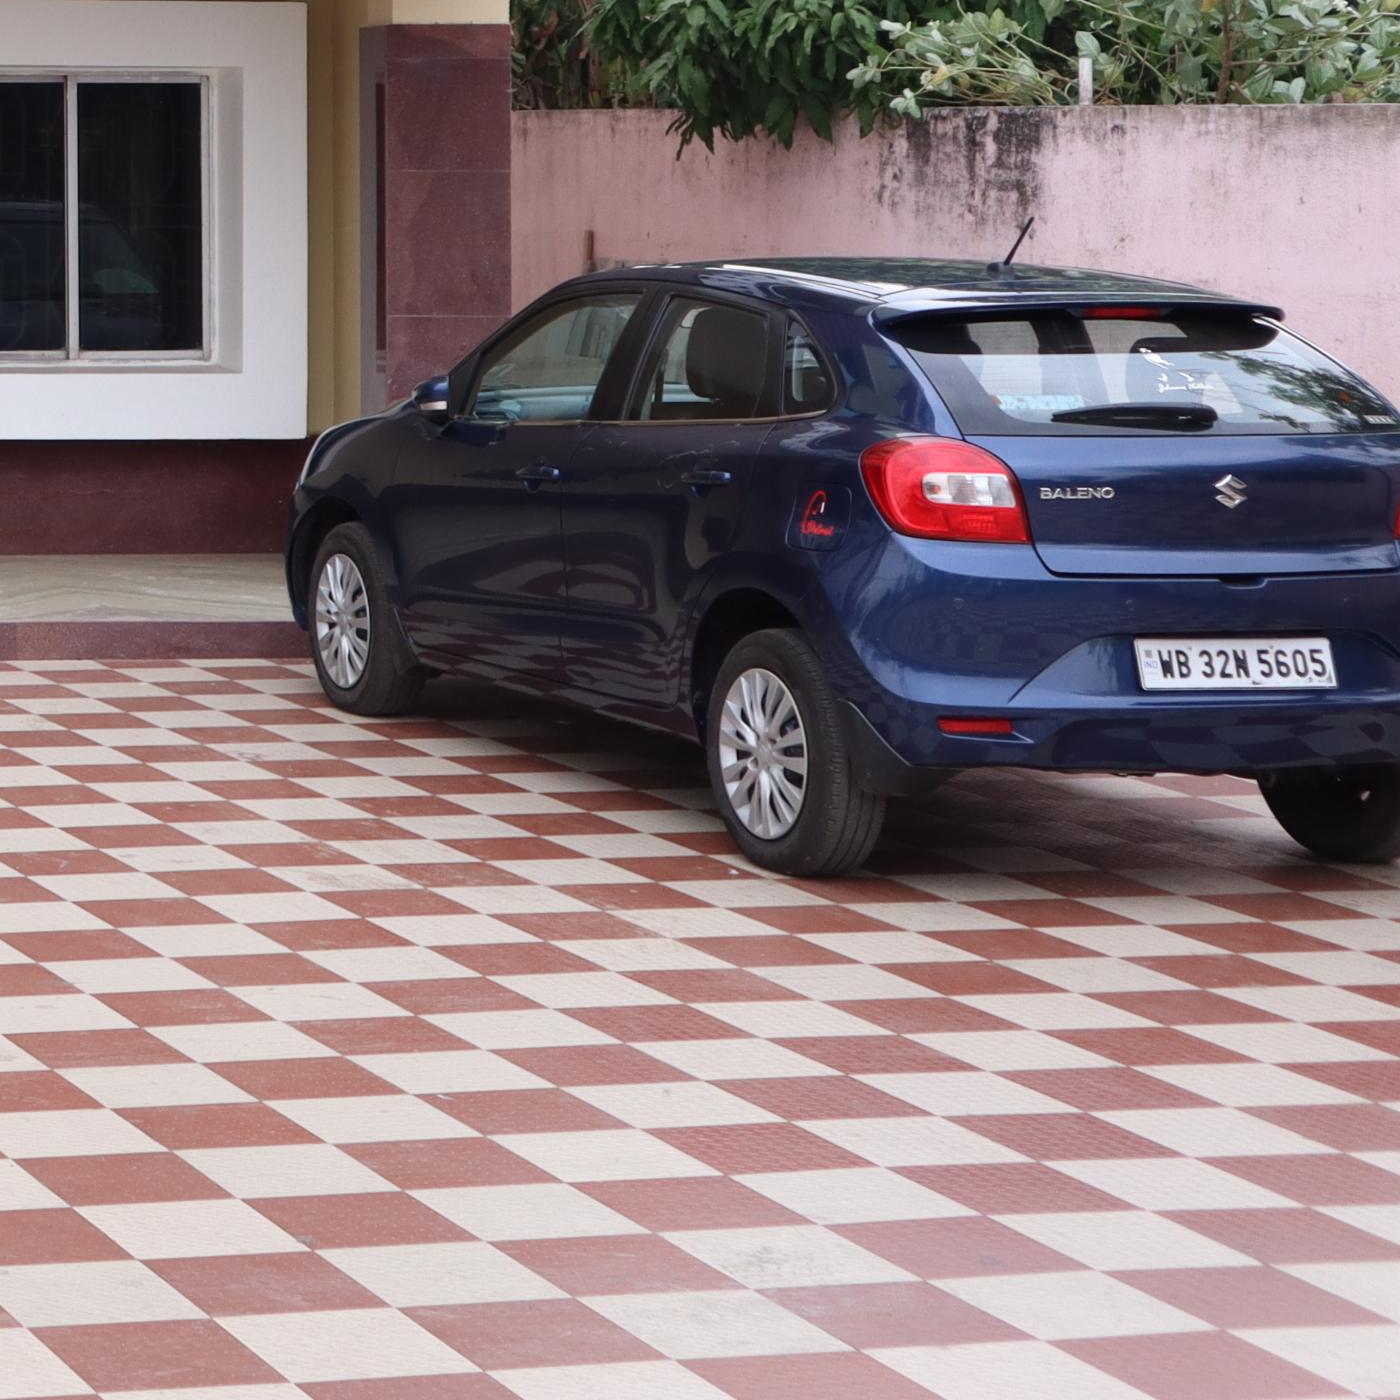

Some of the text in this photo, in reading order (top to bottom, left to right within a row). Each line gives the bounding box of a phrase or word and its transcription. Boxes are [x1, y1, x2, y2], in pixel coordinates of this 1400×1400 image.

[1039, 486, 1115, 499] BALENO
[1157, 648, 1327, 679] WB 32N 5605
